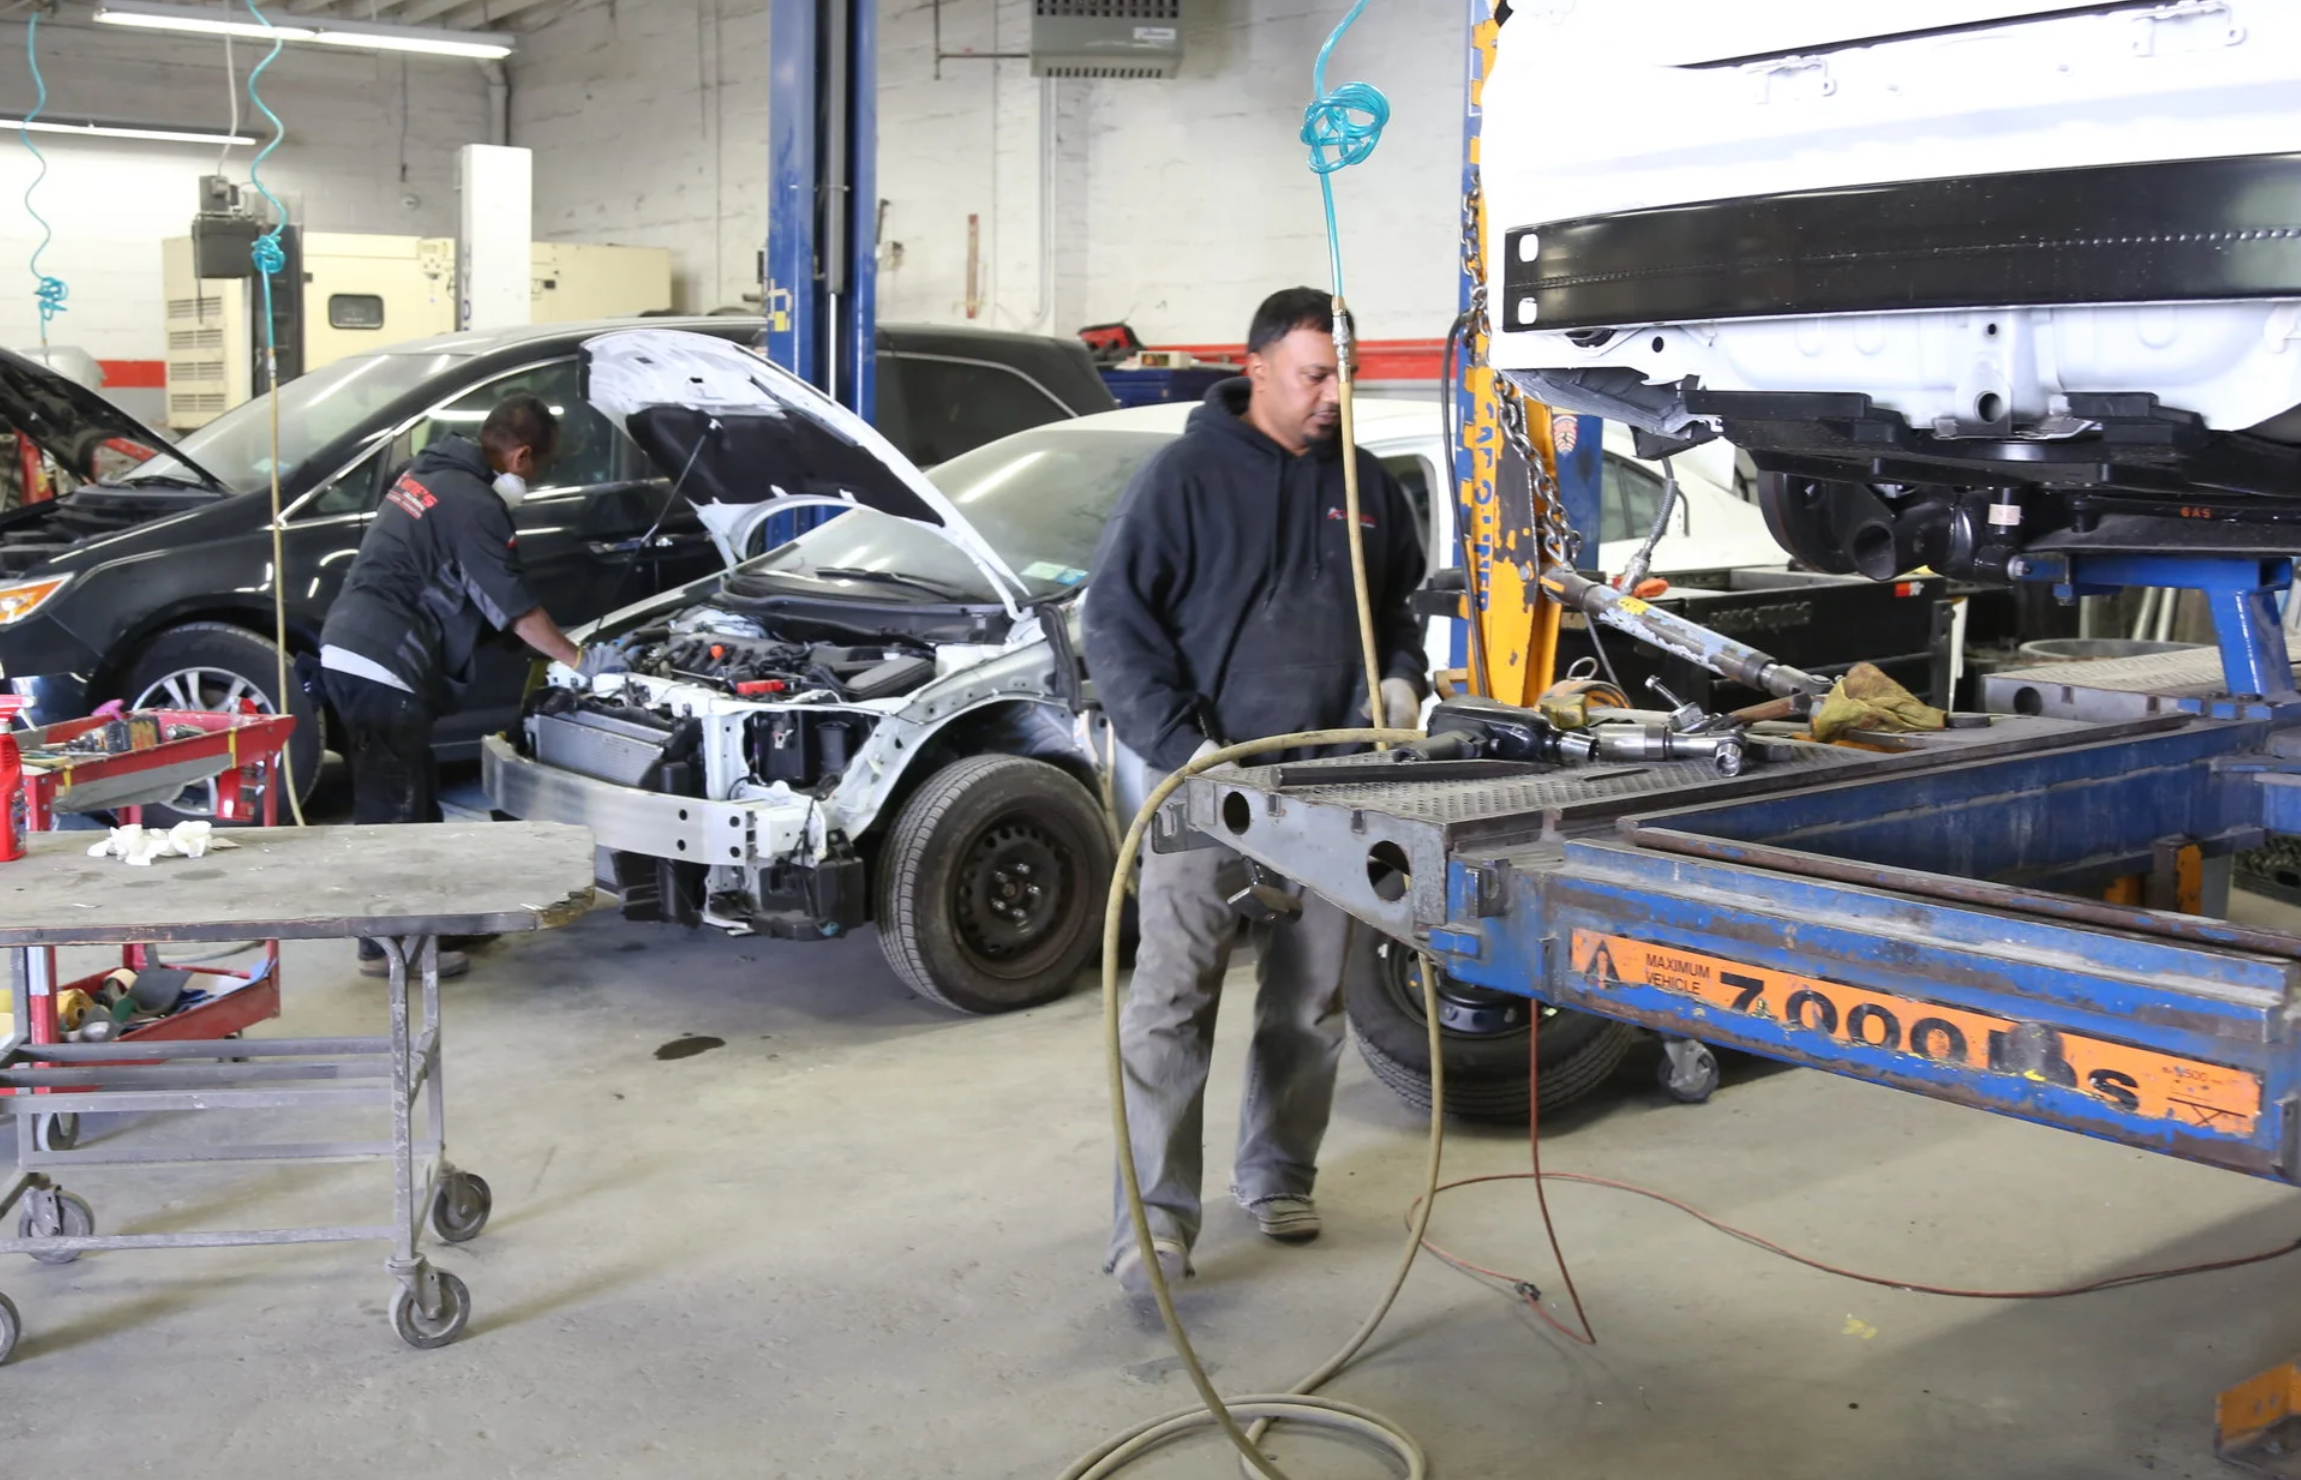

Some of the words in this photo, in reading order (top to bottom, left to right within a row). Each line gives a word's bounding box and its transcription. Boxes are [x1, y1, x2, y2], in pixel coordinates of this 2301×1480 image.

[2180, 506, 2211, 518] GAS
[1646, 953, 1710, 978] MAXIMUM
[1645, 971, 1701, 995] VEHICLE
